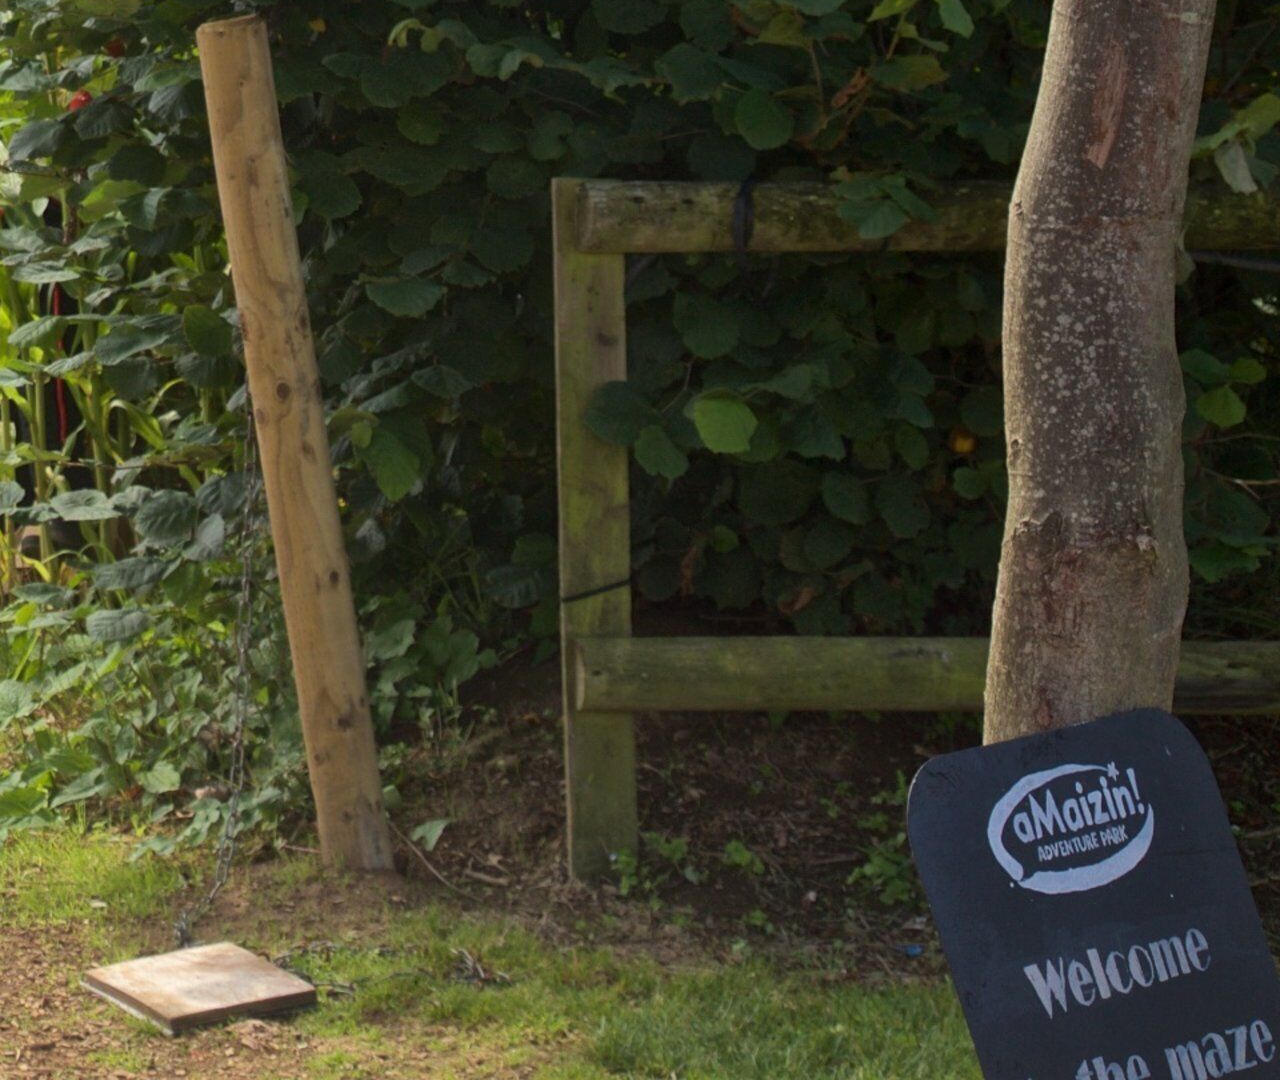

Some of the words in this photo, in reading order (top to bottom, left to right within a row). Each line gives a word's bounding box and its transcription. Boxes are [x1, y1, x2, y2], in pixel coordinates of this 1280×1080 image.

[1012, 767, 1145, 844] aMaizin!
[1037, 831, 1100, 862] ADVENTURE
[1099, 824, 1129, 848] PARK
[1023, 927, 1212, 1020] Welcome
[1164, 1019, 1276, 1080] maze
